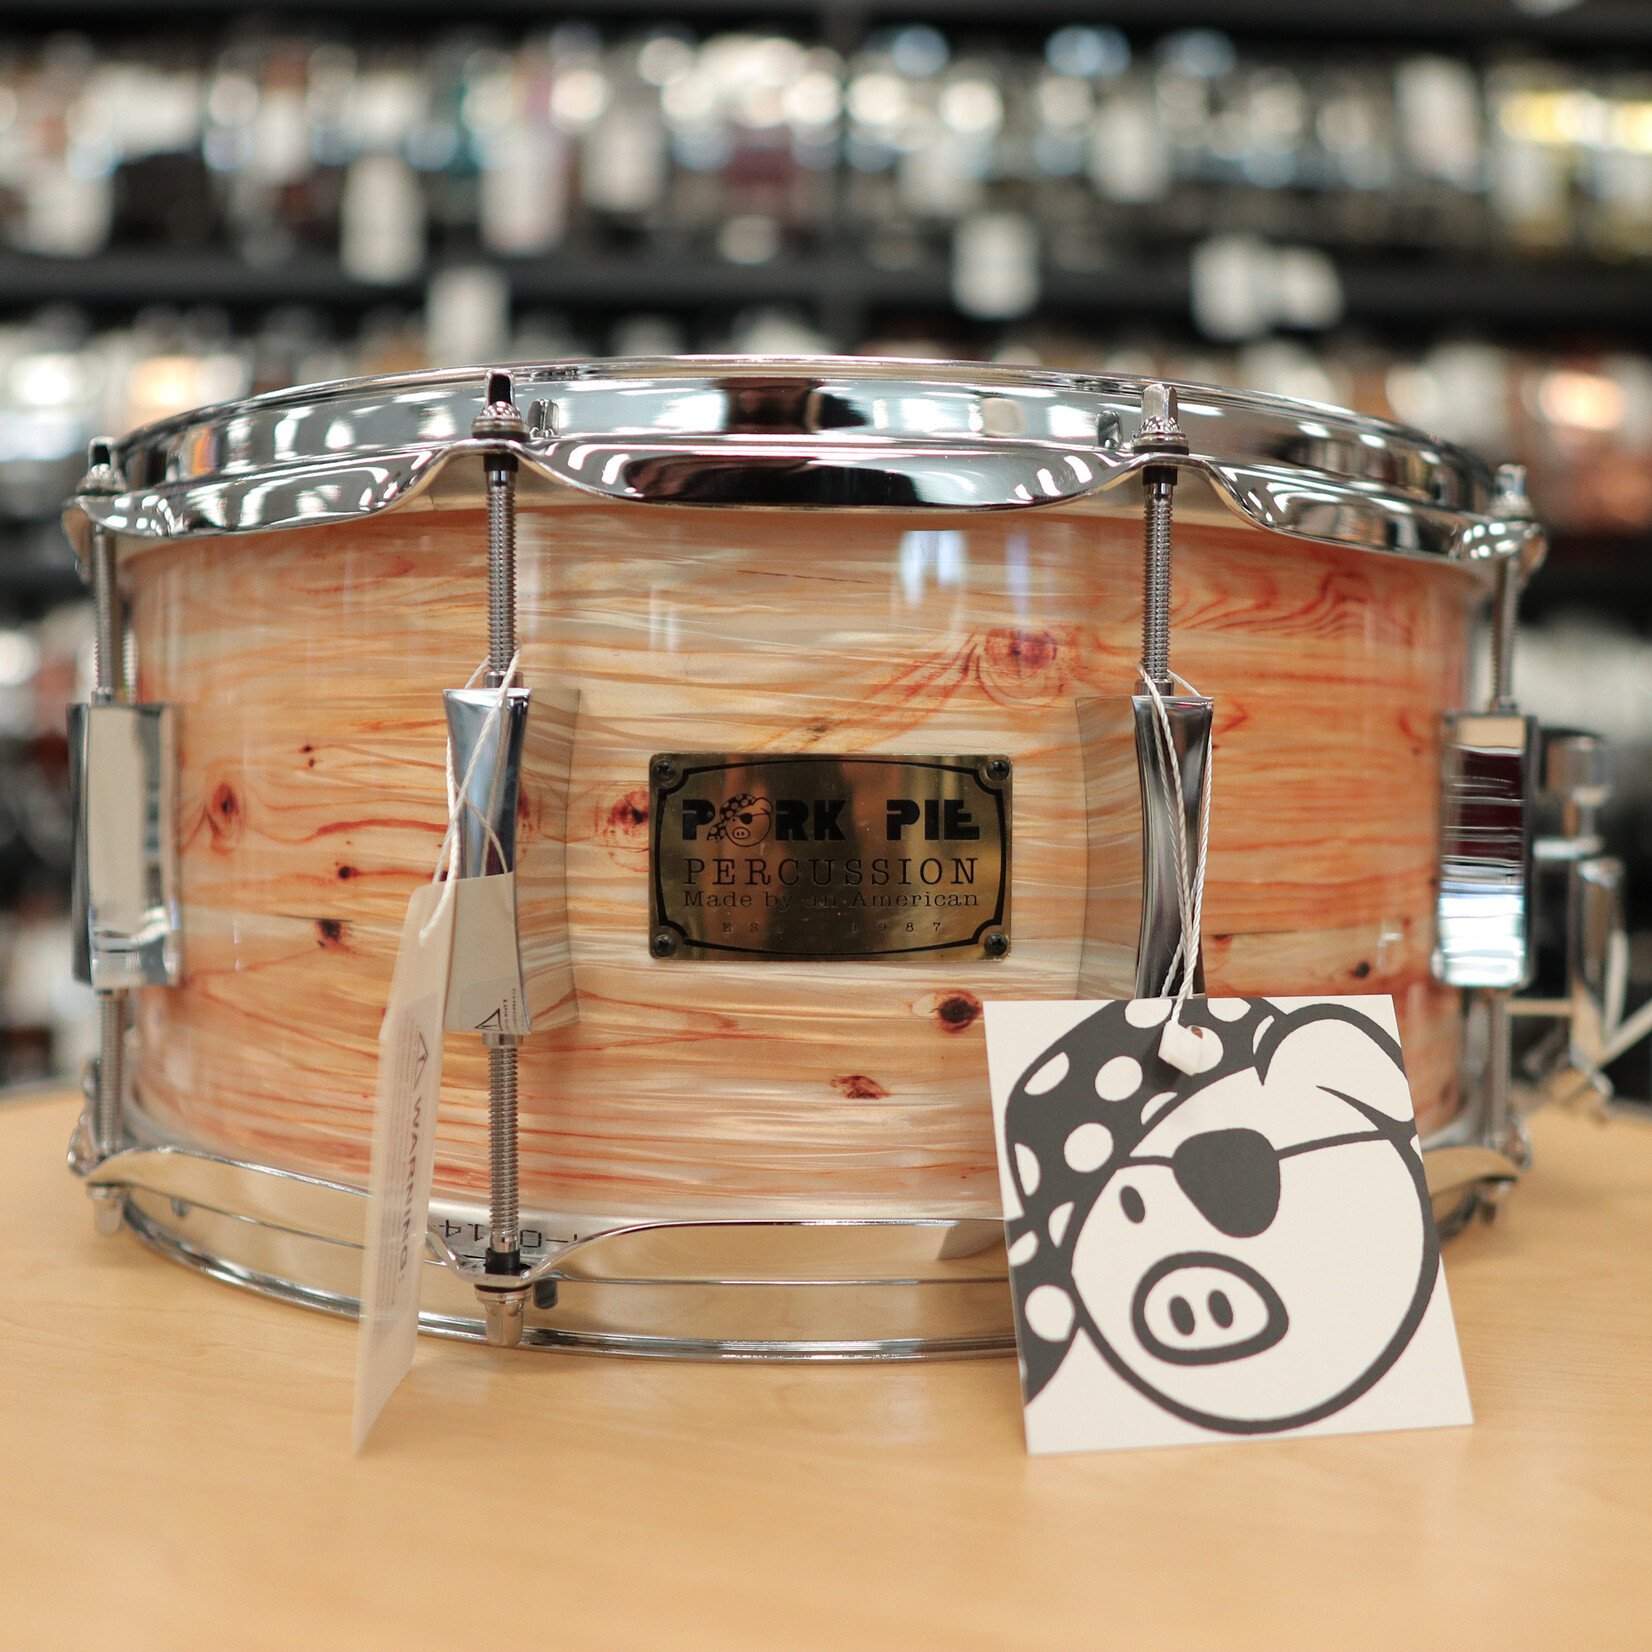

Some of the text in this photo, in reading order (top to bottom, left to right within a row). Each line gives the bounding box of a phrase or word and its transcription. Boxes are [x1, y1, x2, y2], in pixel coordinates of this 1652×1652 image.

[886, 799, 980, 841] PIE
[682, 858, 979, 886] PERCUSSION
[683, 891, 753, 907] Made
[764, 891, 793, 912] by
[851, 891, 979, 908] American
